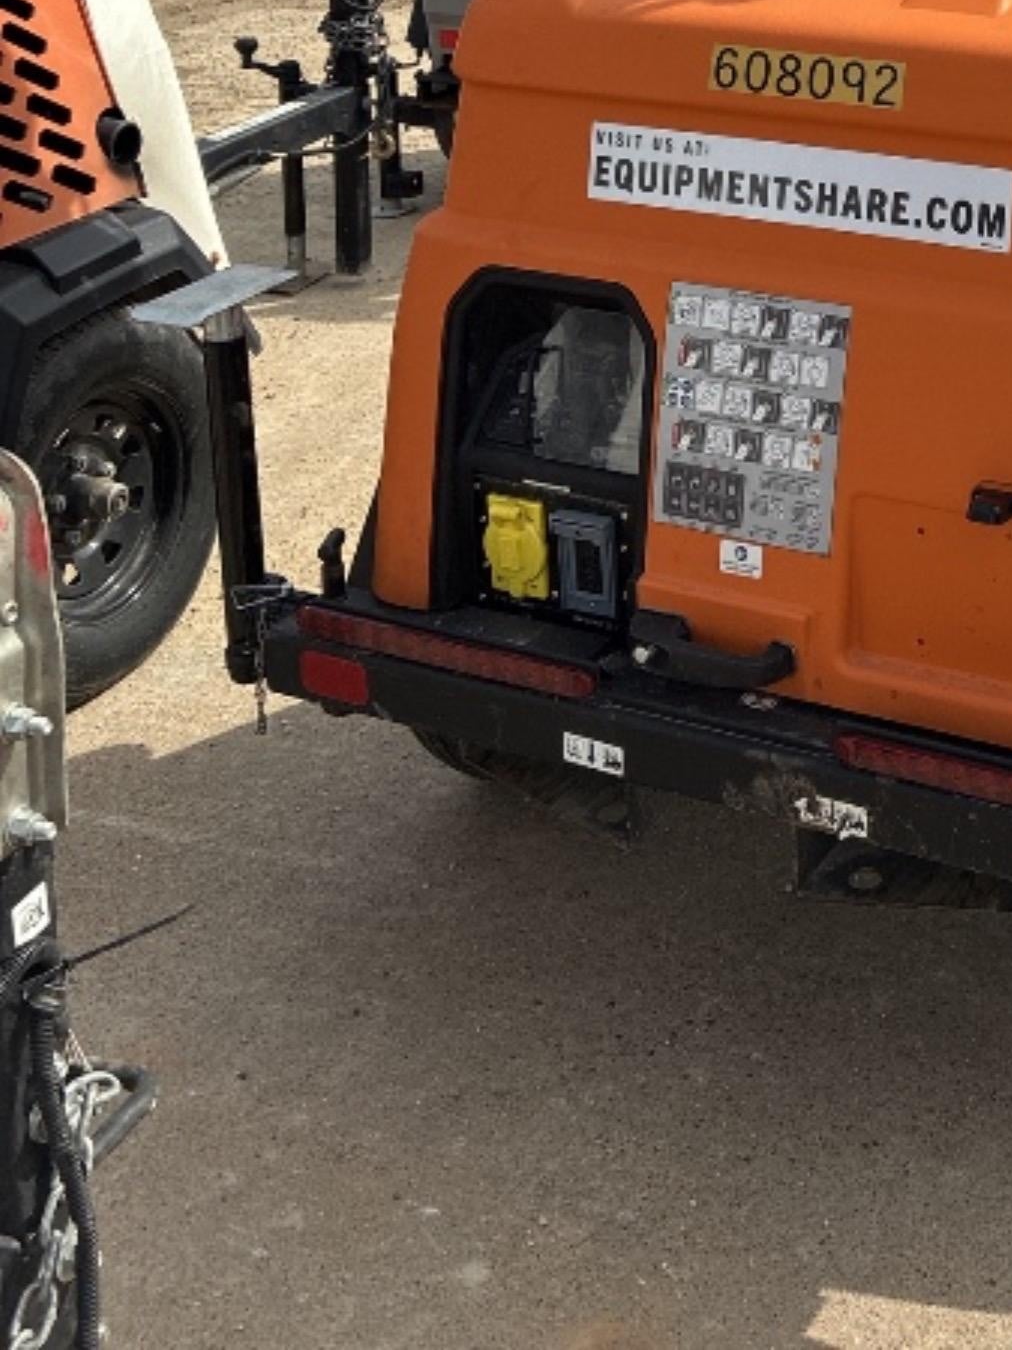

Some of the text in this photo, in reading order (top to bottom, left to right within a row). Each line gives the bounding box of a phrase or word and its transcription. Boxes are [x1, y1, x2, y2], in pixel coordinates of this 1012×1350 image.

[714, 48, 899, 106] 608092
[596, 130, 643, 150] VISIT
[652, 134, 674, 154] US
[593, 155, 1007, 239] EQUIPMENTSHARE.COM
